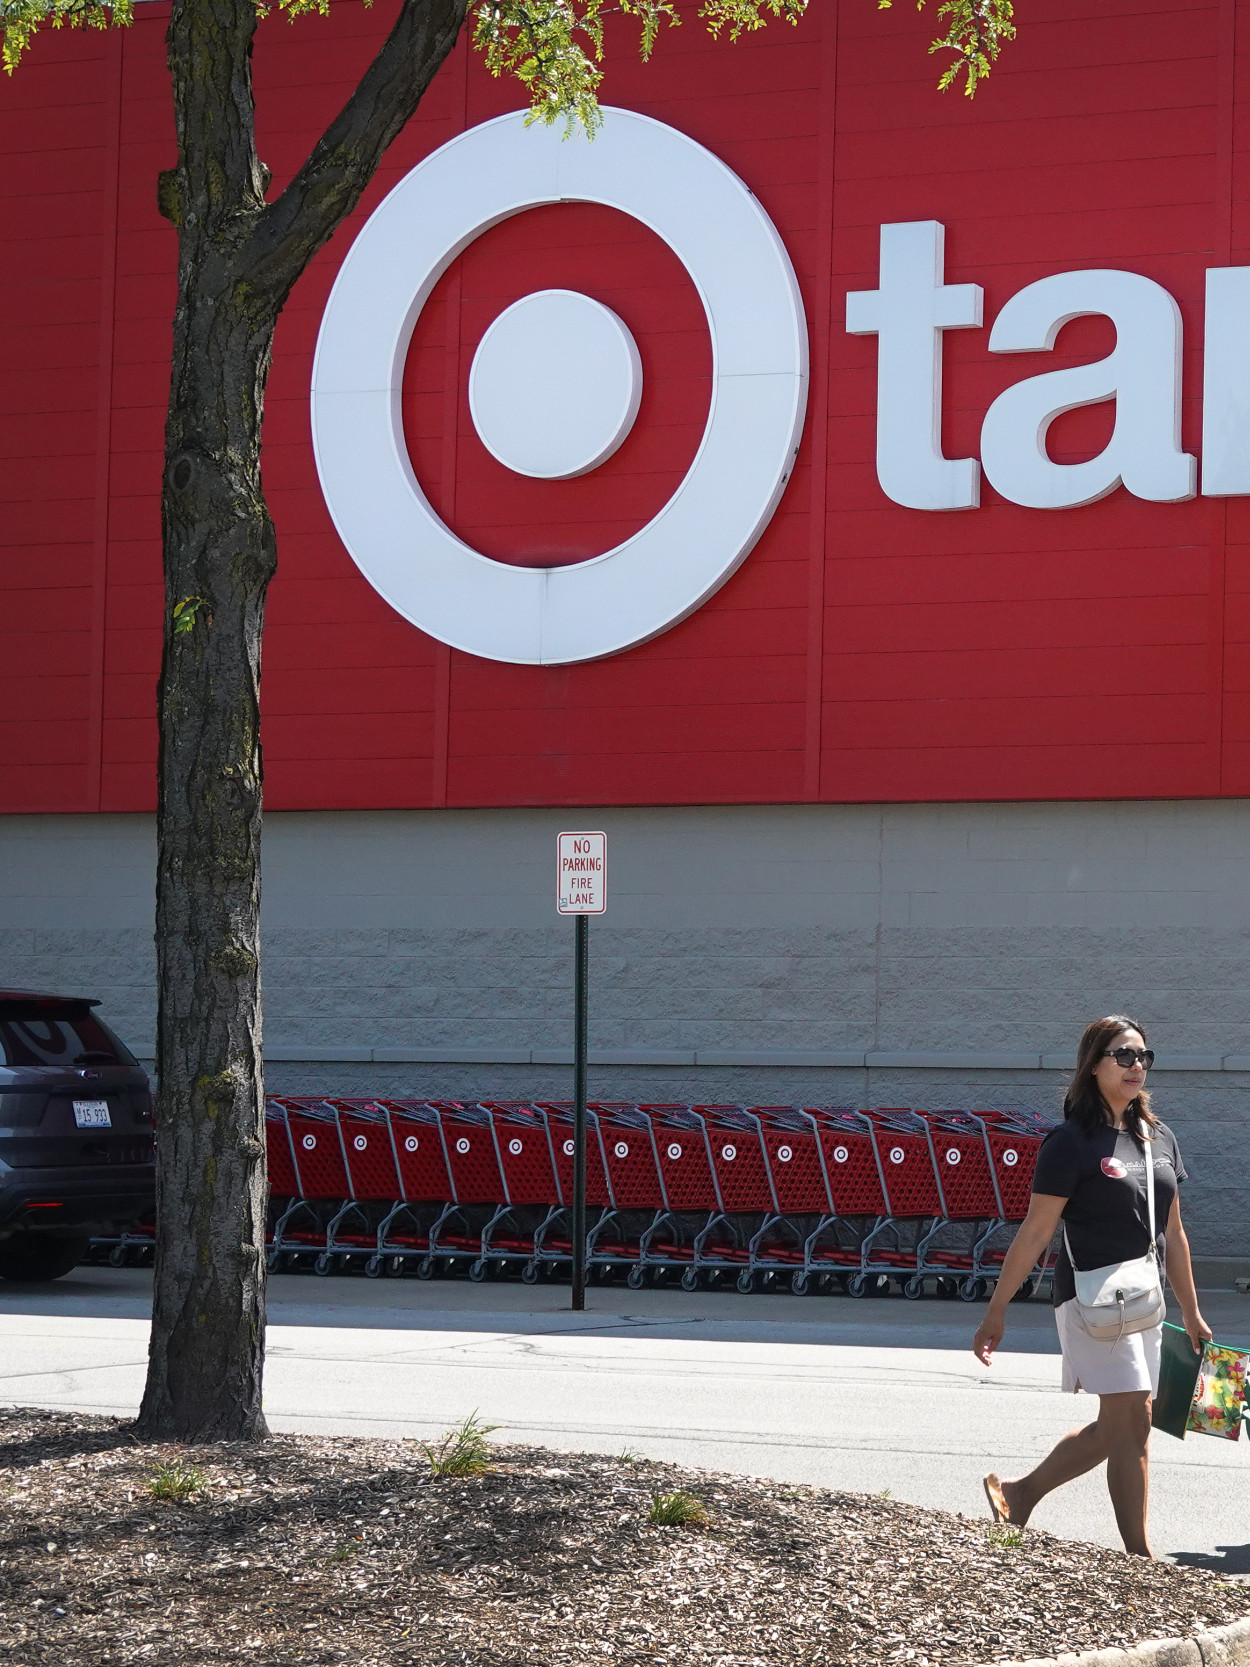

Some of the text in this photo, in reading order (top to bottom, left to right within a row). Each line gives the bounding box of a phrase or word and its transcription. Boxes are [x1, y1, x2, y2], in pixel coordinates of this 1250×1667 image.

[573, 839, 591, 854] NO
[562, 857, 602, 872] PARKING
[571, 877, 593, 889] FIRE
[569, 893, 595, 905] LANE
